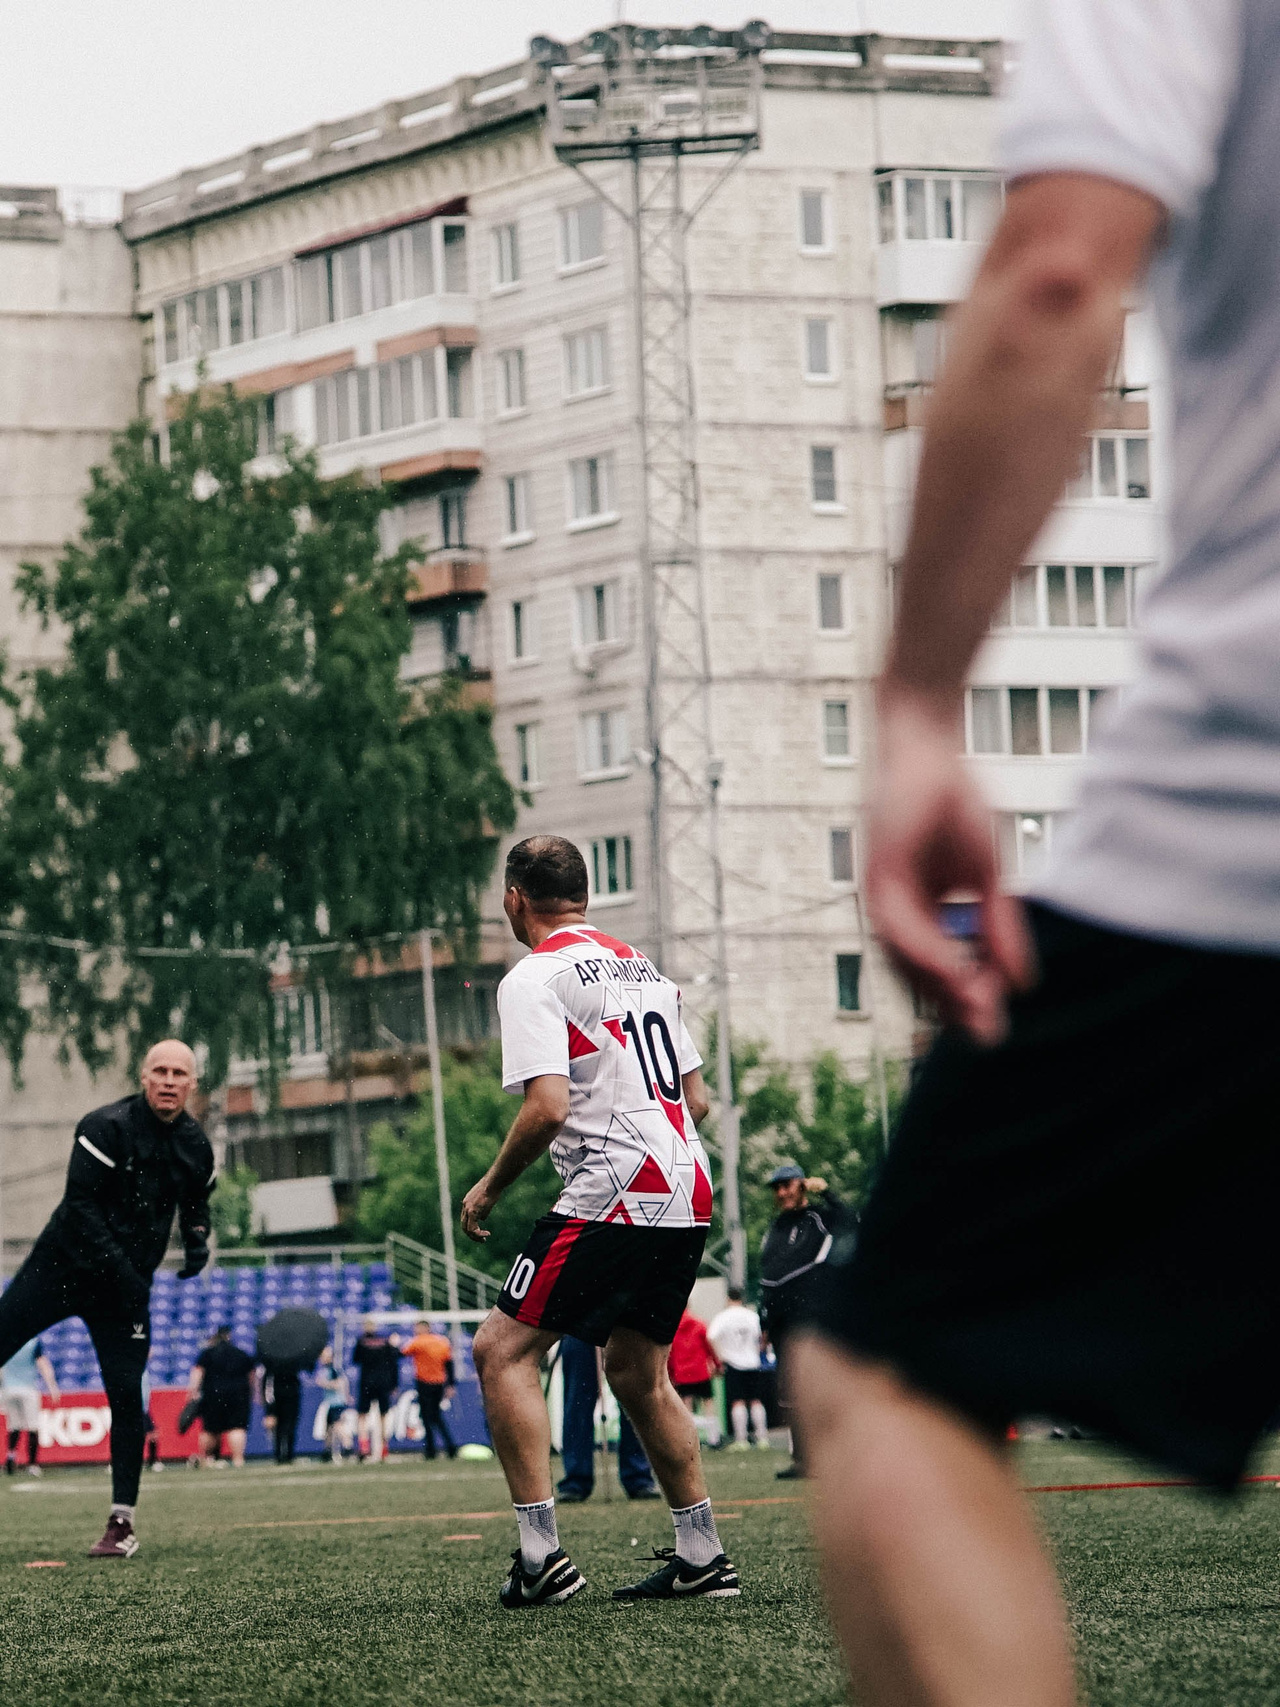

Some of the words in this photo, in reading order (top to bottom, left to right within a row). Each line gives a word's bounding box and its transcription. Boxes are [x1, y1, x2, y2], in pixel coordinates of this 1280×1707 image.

[574, 958, 667, 987] АРТАМОНО
[622, 1010, 681, 1102] 10
[503, 1252, 536, 1300] 10
[38, 1406, 112, 1448] KD
[528, 1503, 547, 1511] PRO
